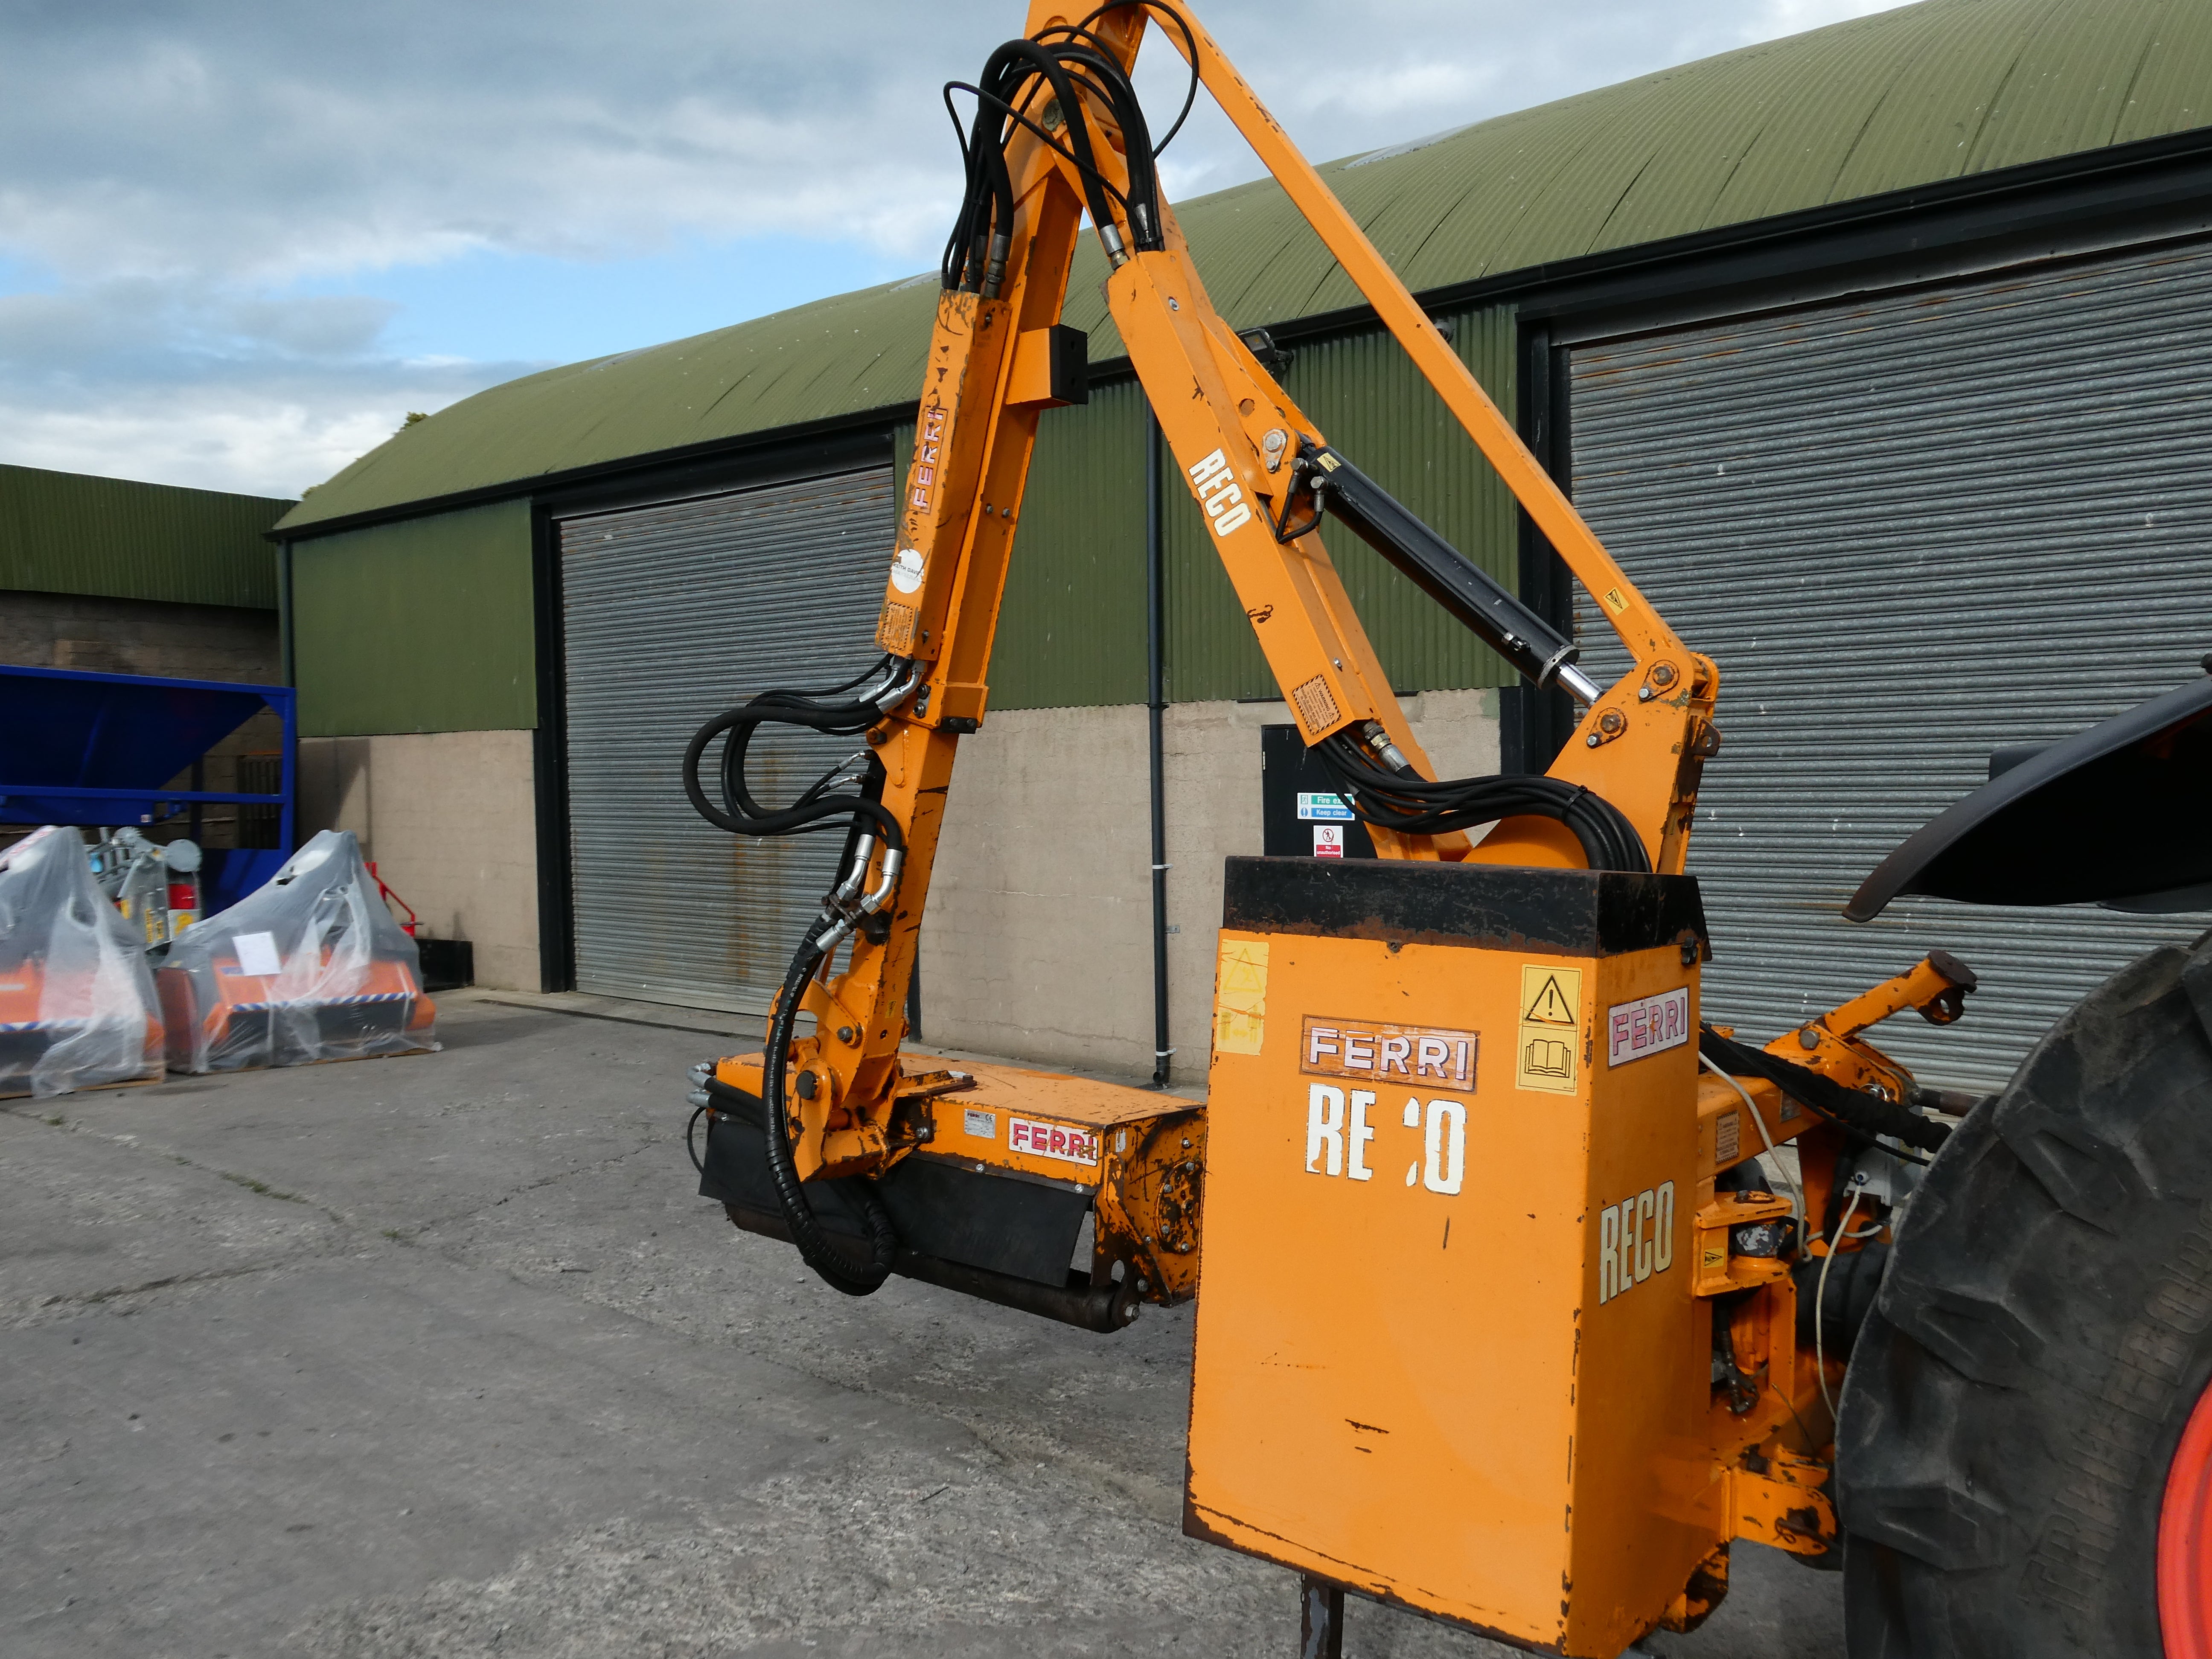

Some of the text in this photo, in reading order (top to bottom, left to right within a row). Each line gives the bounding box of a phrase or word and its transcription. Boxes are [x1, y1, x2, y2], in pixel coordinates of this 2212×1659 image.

[913, 410, 943, 507] FERRI
[1188, 448, 1252, 537] RECO
[1318, 689, 1330, 711] WARNING
[1309, 1026, 1470, 1081] FERRI
[1612, 996, 1685, 1056] FERRI
[1013, 1123, 1094, 1160] FERRI
[1600, 1180, 1674, 1305] RECO
